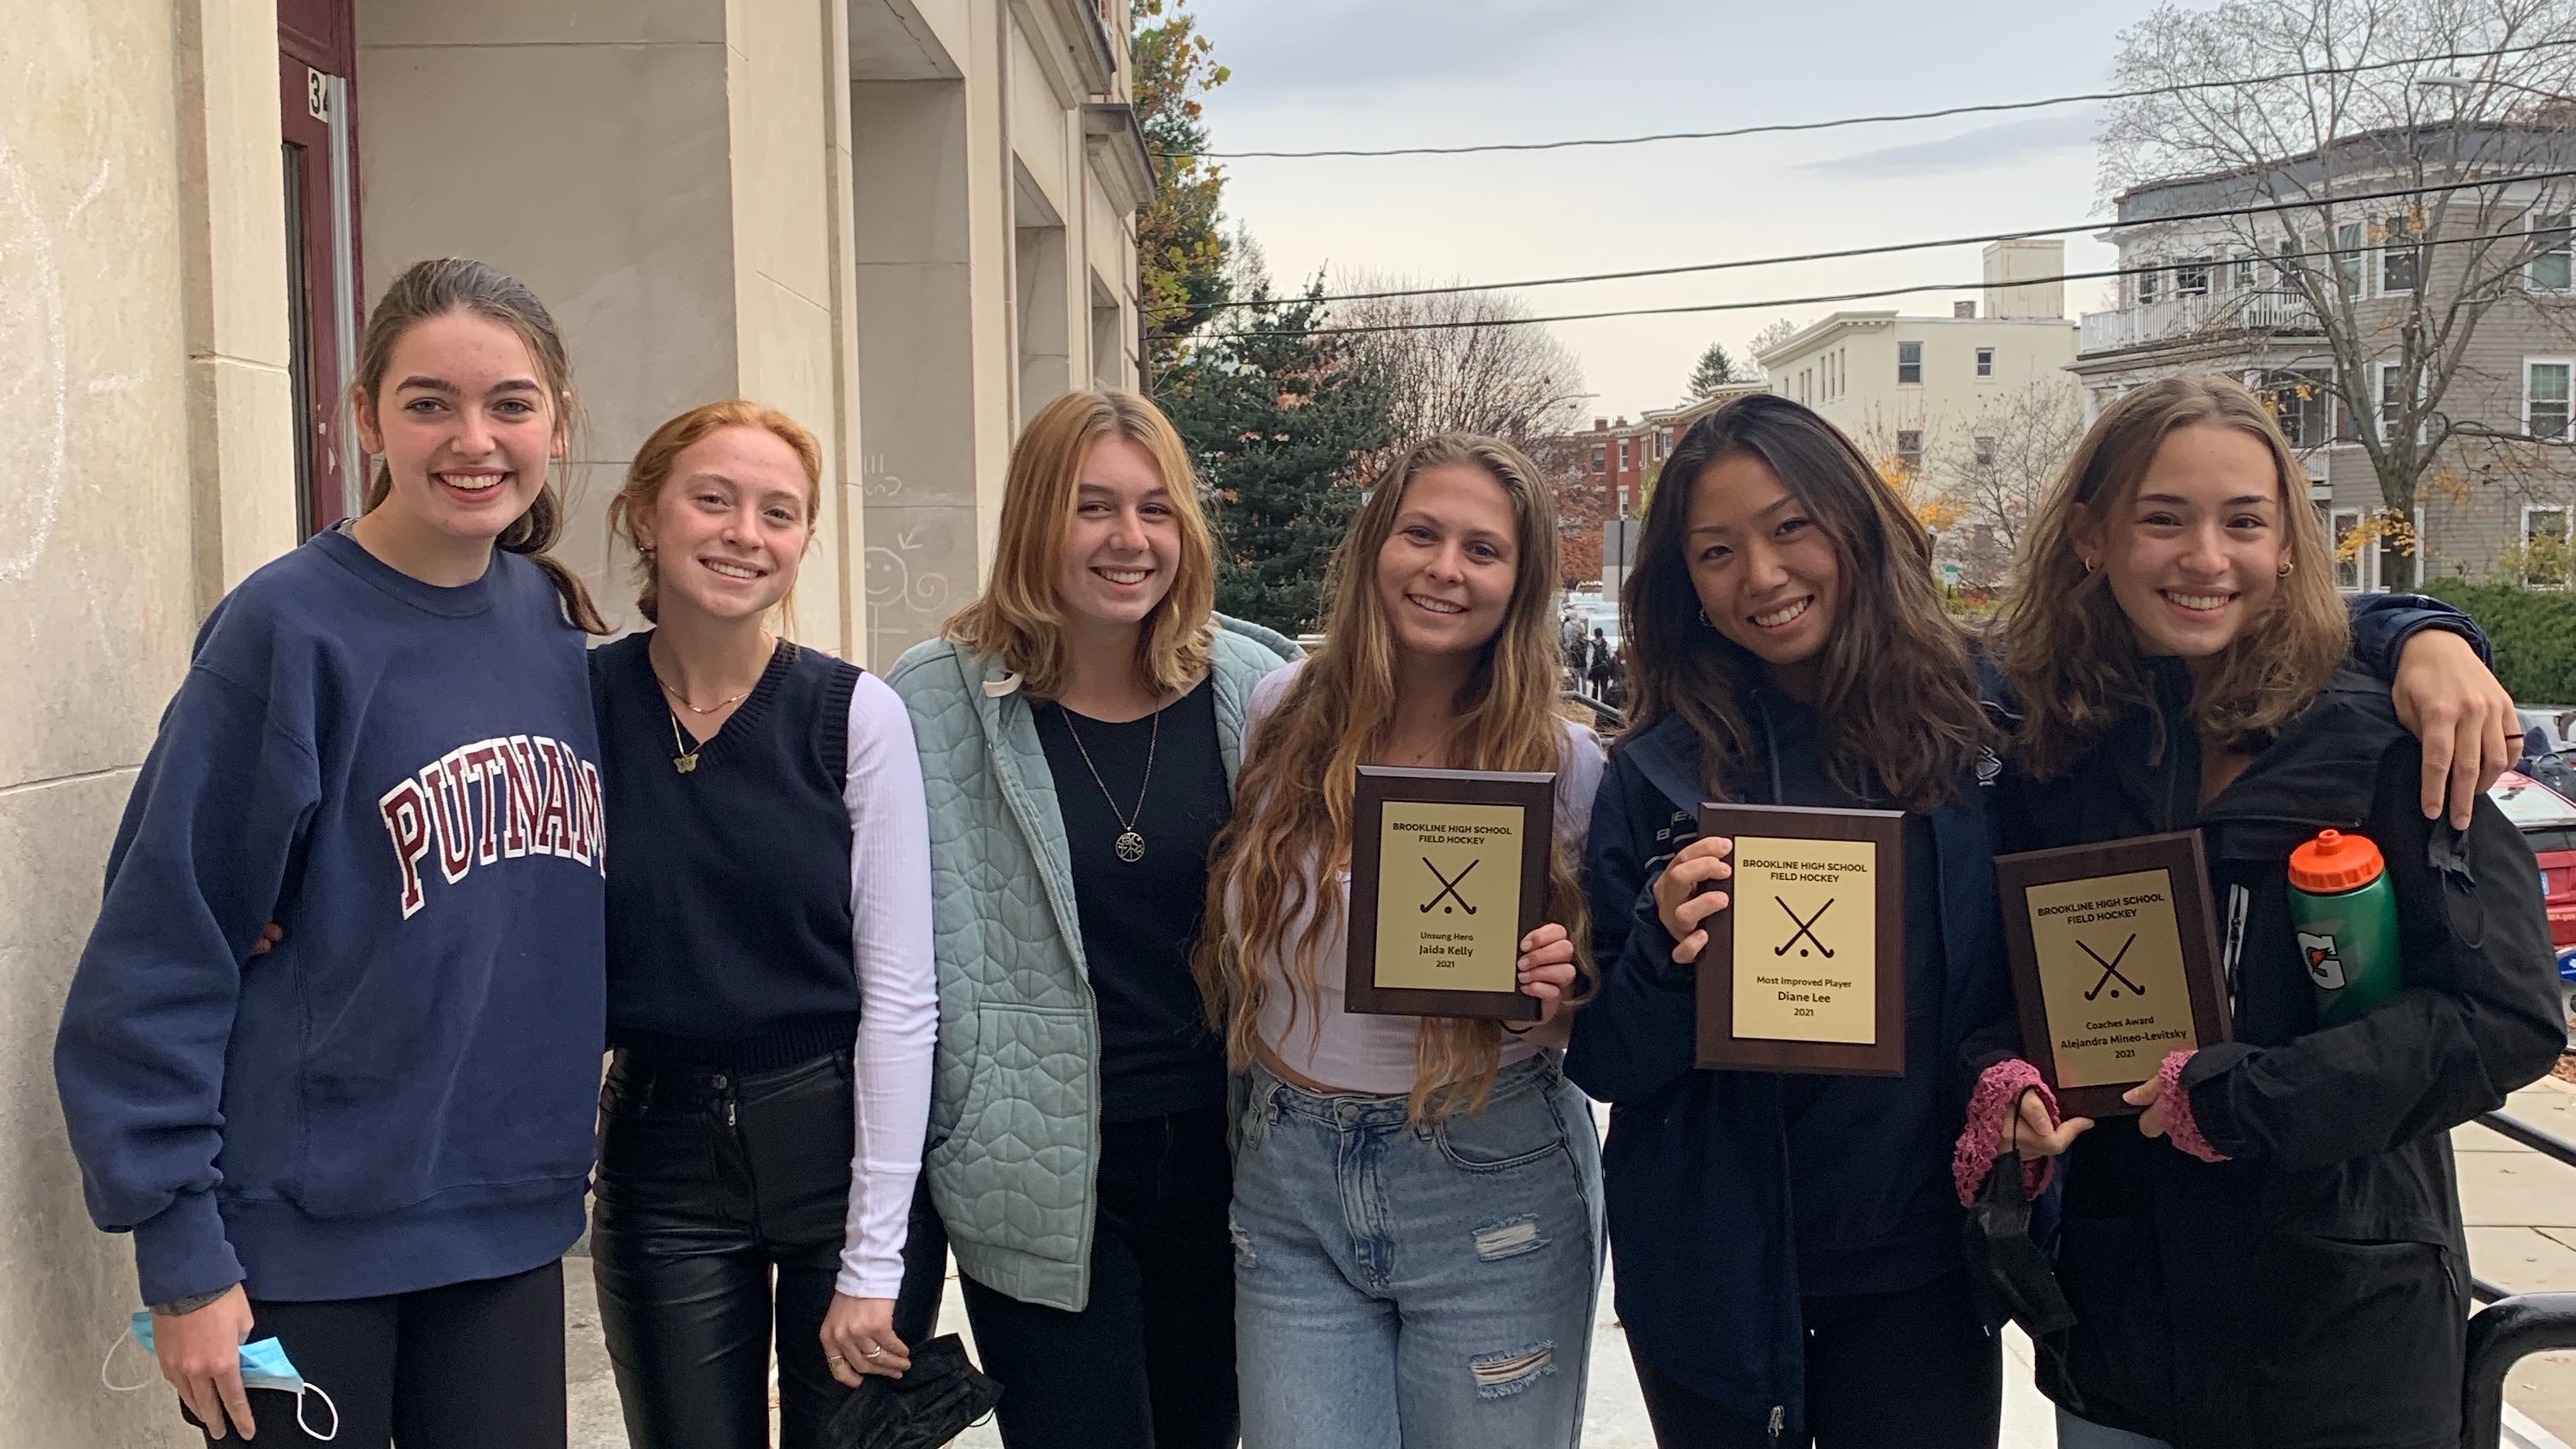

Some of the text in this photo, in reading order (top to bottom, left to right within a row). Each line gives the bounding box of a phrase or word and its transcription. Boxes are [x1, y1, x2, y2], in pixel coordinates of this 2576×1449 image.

[378, 734, 607, 921] PUTNAM
[1393, 823, 1512, 835] BROOKLINE HIGH SCHOOL
[1418, 835, 1486, 845] FIELD HOCKEY
[1742, 859, 1867, 873] BROOKLINE HIGH SCHOOL
[1770, 872, 1840, 883] FIELD HOCKEY
[2038, 893, 2165, 917] BROOKLINE HIGH SCHOOL
[2067, 908, 2137, 925] FIELD HOCKEY
[1420, 932, 1474, 942] Unsung Hero
[1418, 945, 1474, 957] Jaida Kelly
[1757, 975, 1852, 989] Most Improved Player
[1778, 991, 1831, 1003] Diane Lee
[1794, 1008, 1814, 1016] 2021
[2086, 1015, 2154, 1030] Coaches Award
[2061, 1029, 2188, 1049] Alejandra Mineo-Levitsky
[2114, 1049, 2136, 1059] 2021
